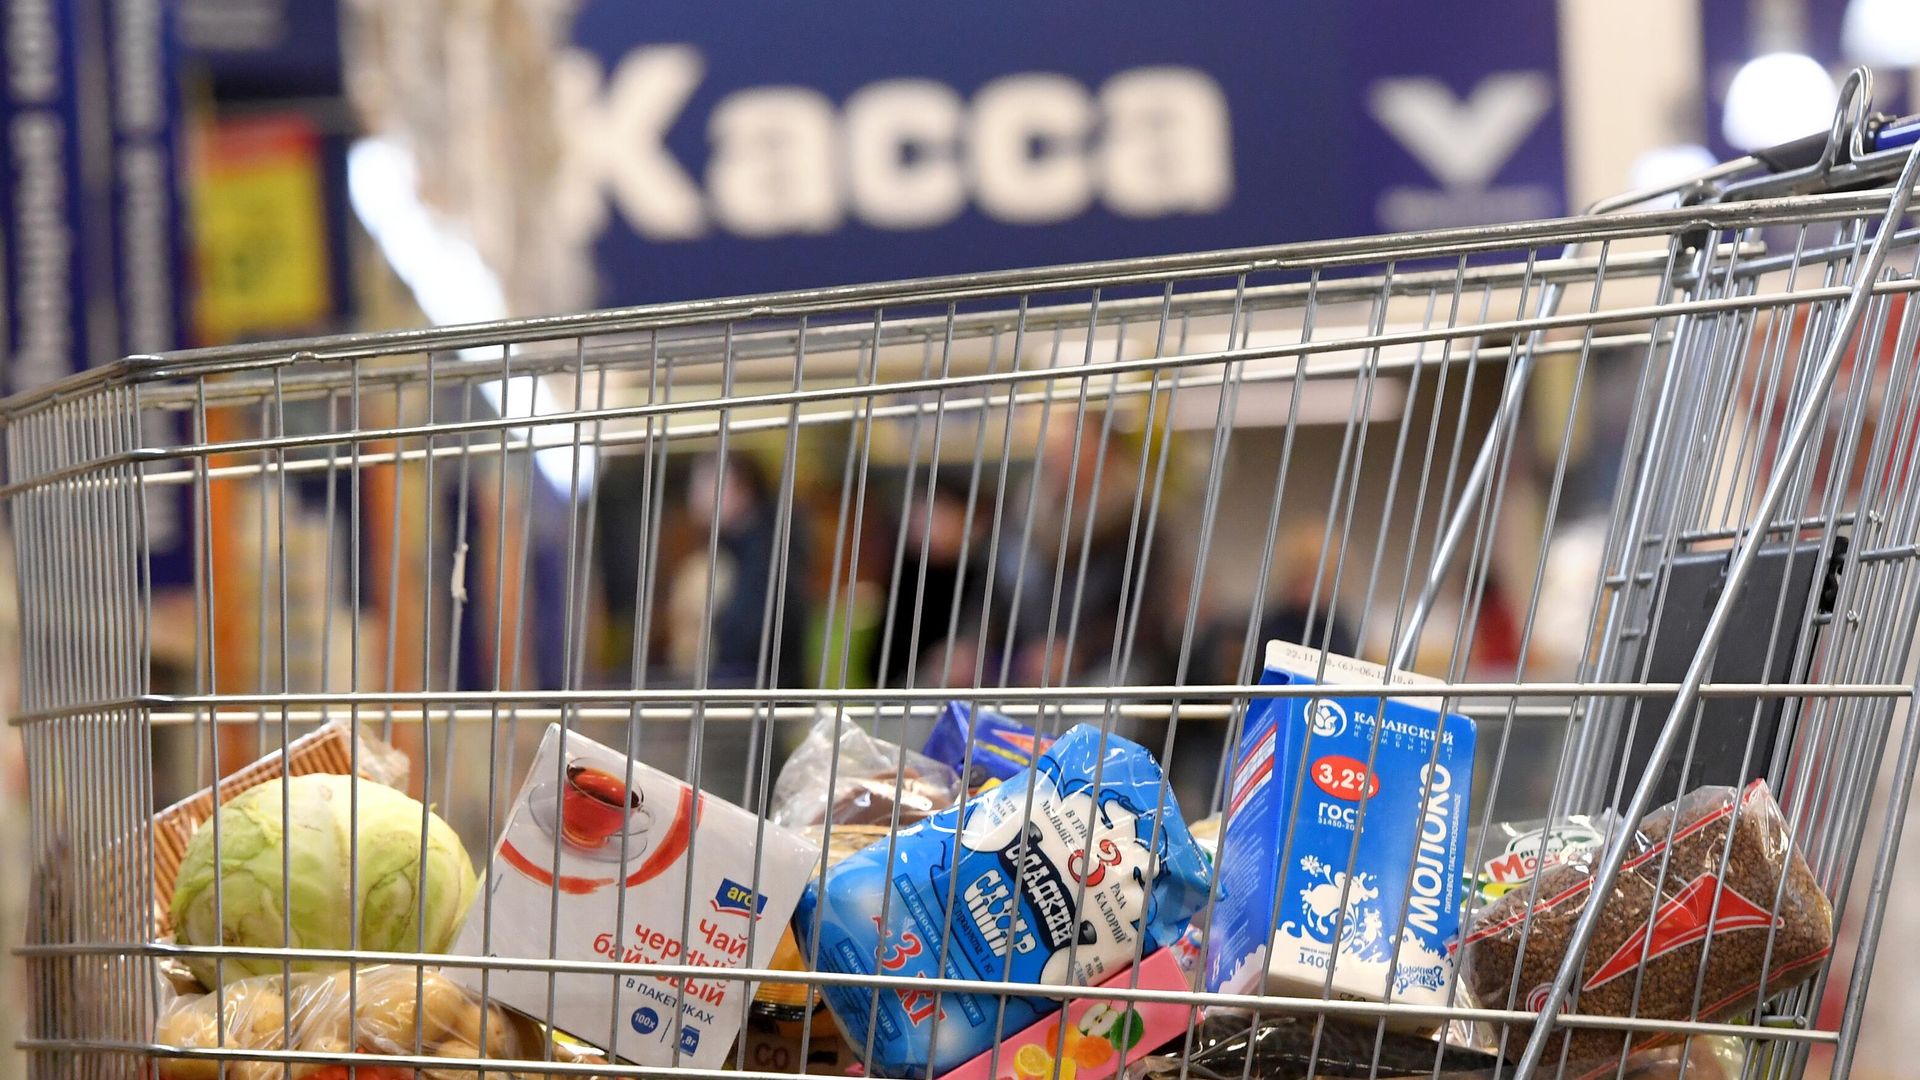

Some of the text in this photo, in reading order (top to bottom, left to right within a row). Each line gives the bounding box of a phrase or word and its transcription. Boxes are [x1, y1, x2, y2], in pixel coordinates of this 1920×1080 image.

[555, 43, 1233, 240] Касса
[1353, 731, 1452, 760] КОМБИНТ
[1354, 724, 1453, 753] МОЛОЧНЙ
[1318, 763, 1374, 794] 3,2%
[1040, 799, 1075, 847] МЕНЬШЕ
[1064, 809, 1074, 818] В
[1067, 839, 1122, 887] 3
[1407, 762, 1451, 935] МОЛОКО
[1445, 793, 1461, 914] ПИТЬЕВОЕ ПАСТЕРИЗОВАННОЕ
[900, 880, 911, 895] по
[909, 894, 938, 945] сладости
[964, 869, 1036, 957] САХАР
[1005, 844, 1074, 947] СЛАДКИЙ
[1110, 882, 1127, 910] РАЗА
[699, 918, 748, 959] Чай
[625, 977, 714, 1025] В ПАКЕТИКАХ
